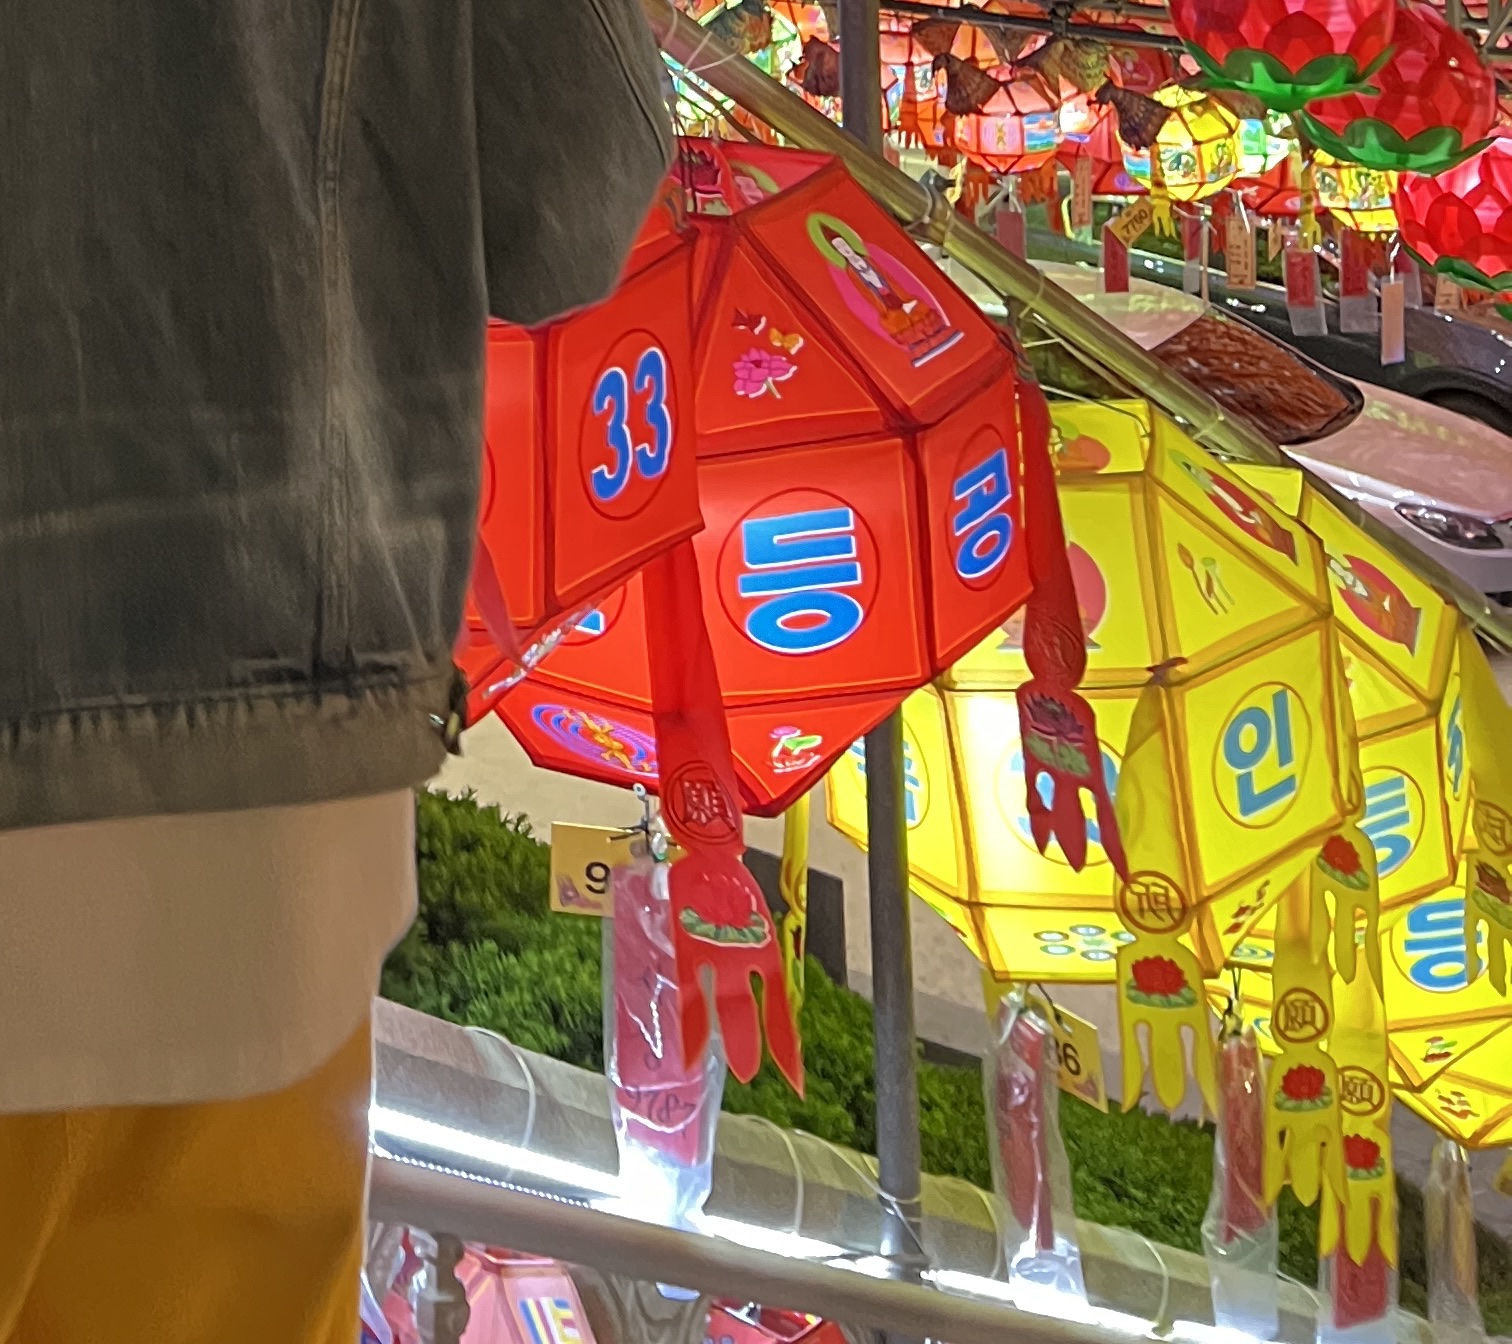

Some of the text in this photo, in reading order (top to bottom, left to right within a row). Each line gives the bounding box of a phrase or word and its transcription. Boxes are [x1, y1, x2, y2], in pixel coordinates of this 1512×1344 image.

[590, 346, 672, 501] 33
[738, 506, 864, 654] 등
[1222, 687, 1297, 818] 인
[1404, 896, 1484, 989] 등
